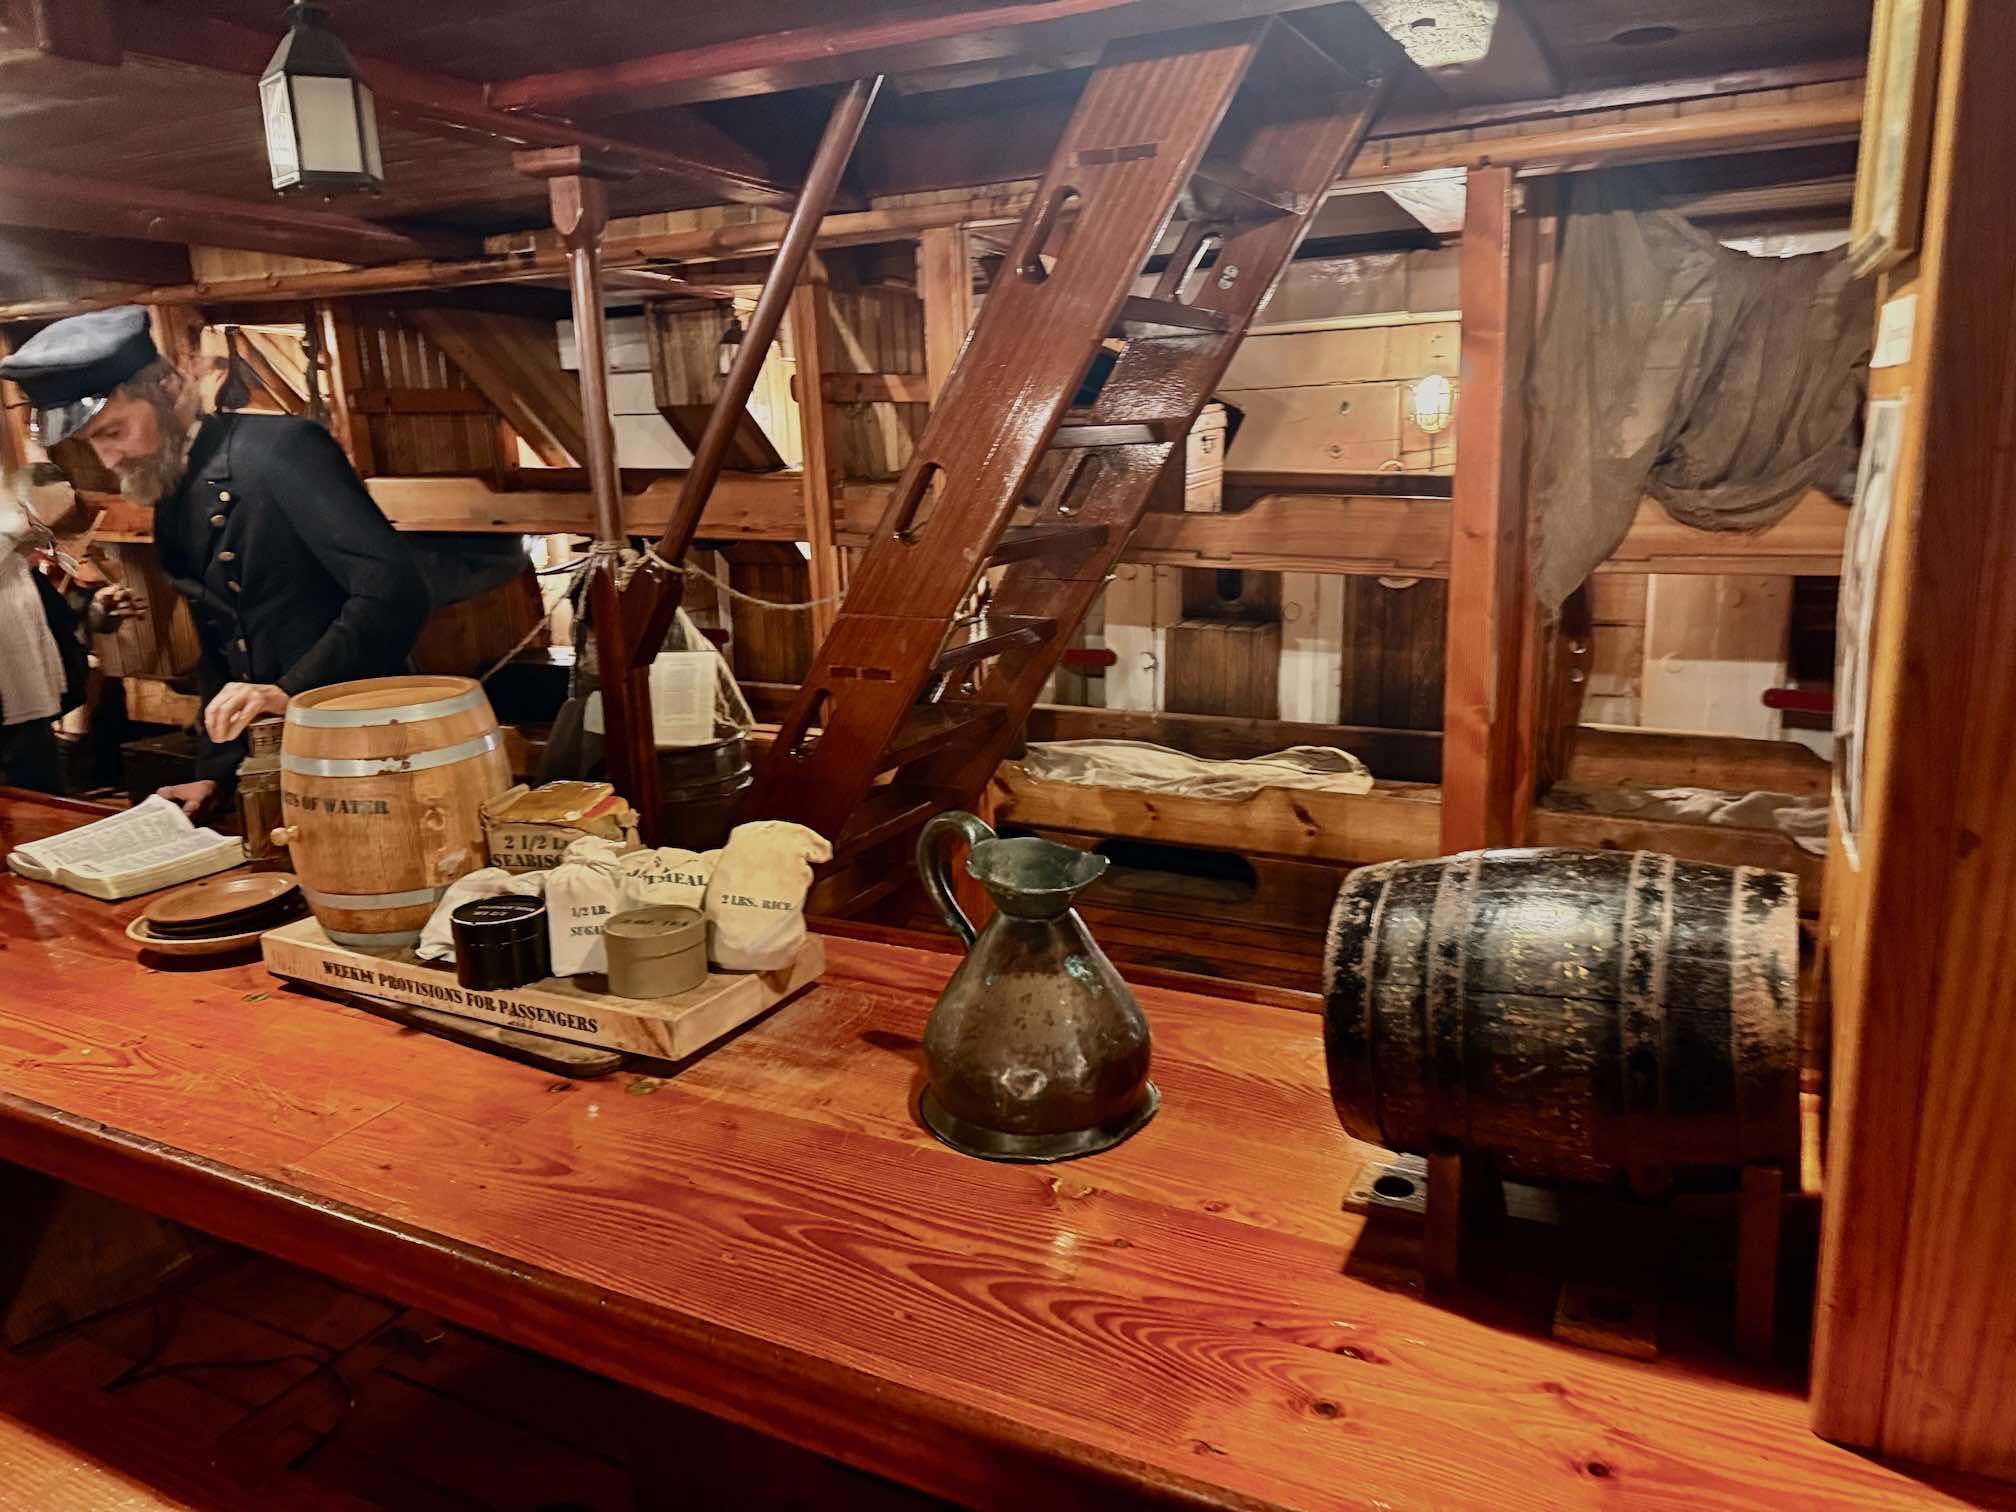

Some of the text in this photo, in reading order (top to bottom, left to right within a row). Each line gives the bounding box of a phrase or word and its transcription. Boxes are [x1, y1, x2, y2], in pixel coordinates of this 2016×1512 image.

[302, 796, 320, 811] OF
[323, 799, 390, 815] WATER
[504, 834, 515, 849] 2
[522, 834, 547, 852] 1/2
[721, 894, 730, 904] 2
[762, 899, 793, 911] RICE
[322, 960, 599, 1034] WEEKLY PROVISIONS FOR PASSENGERS
